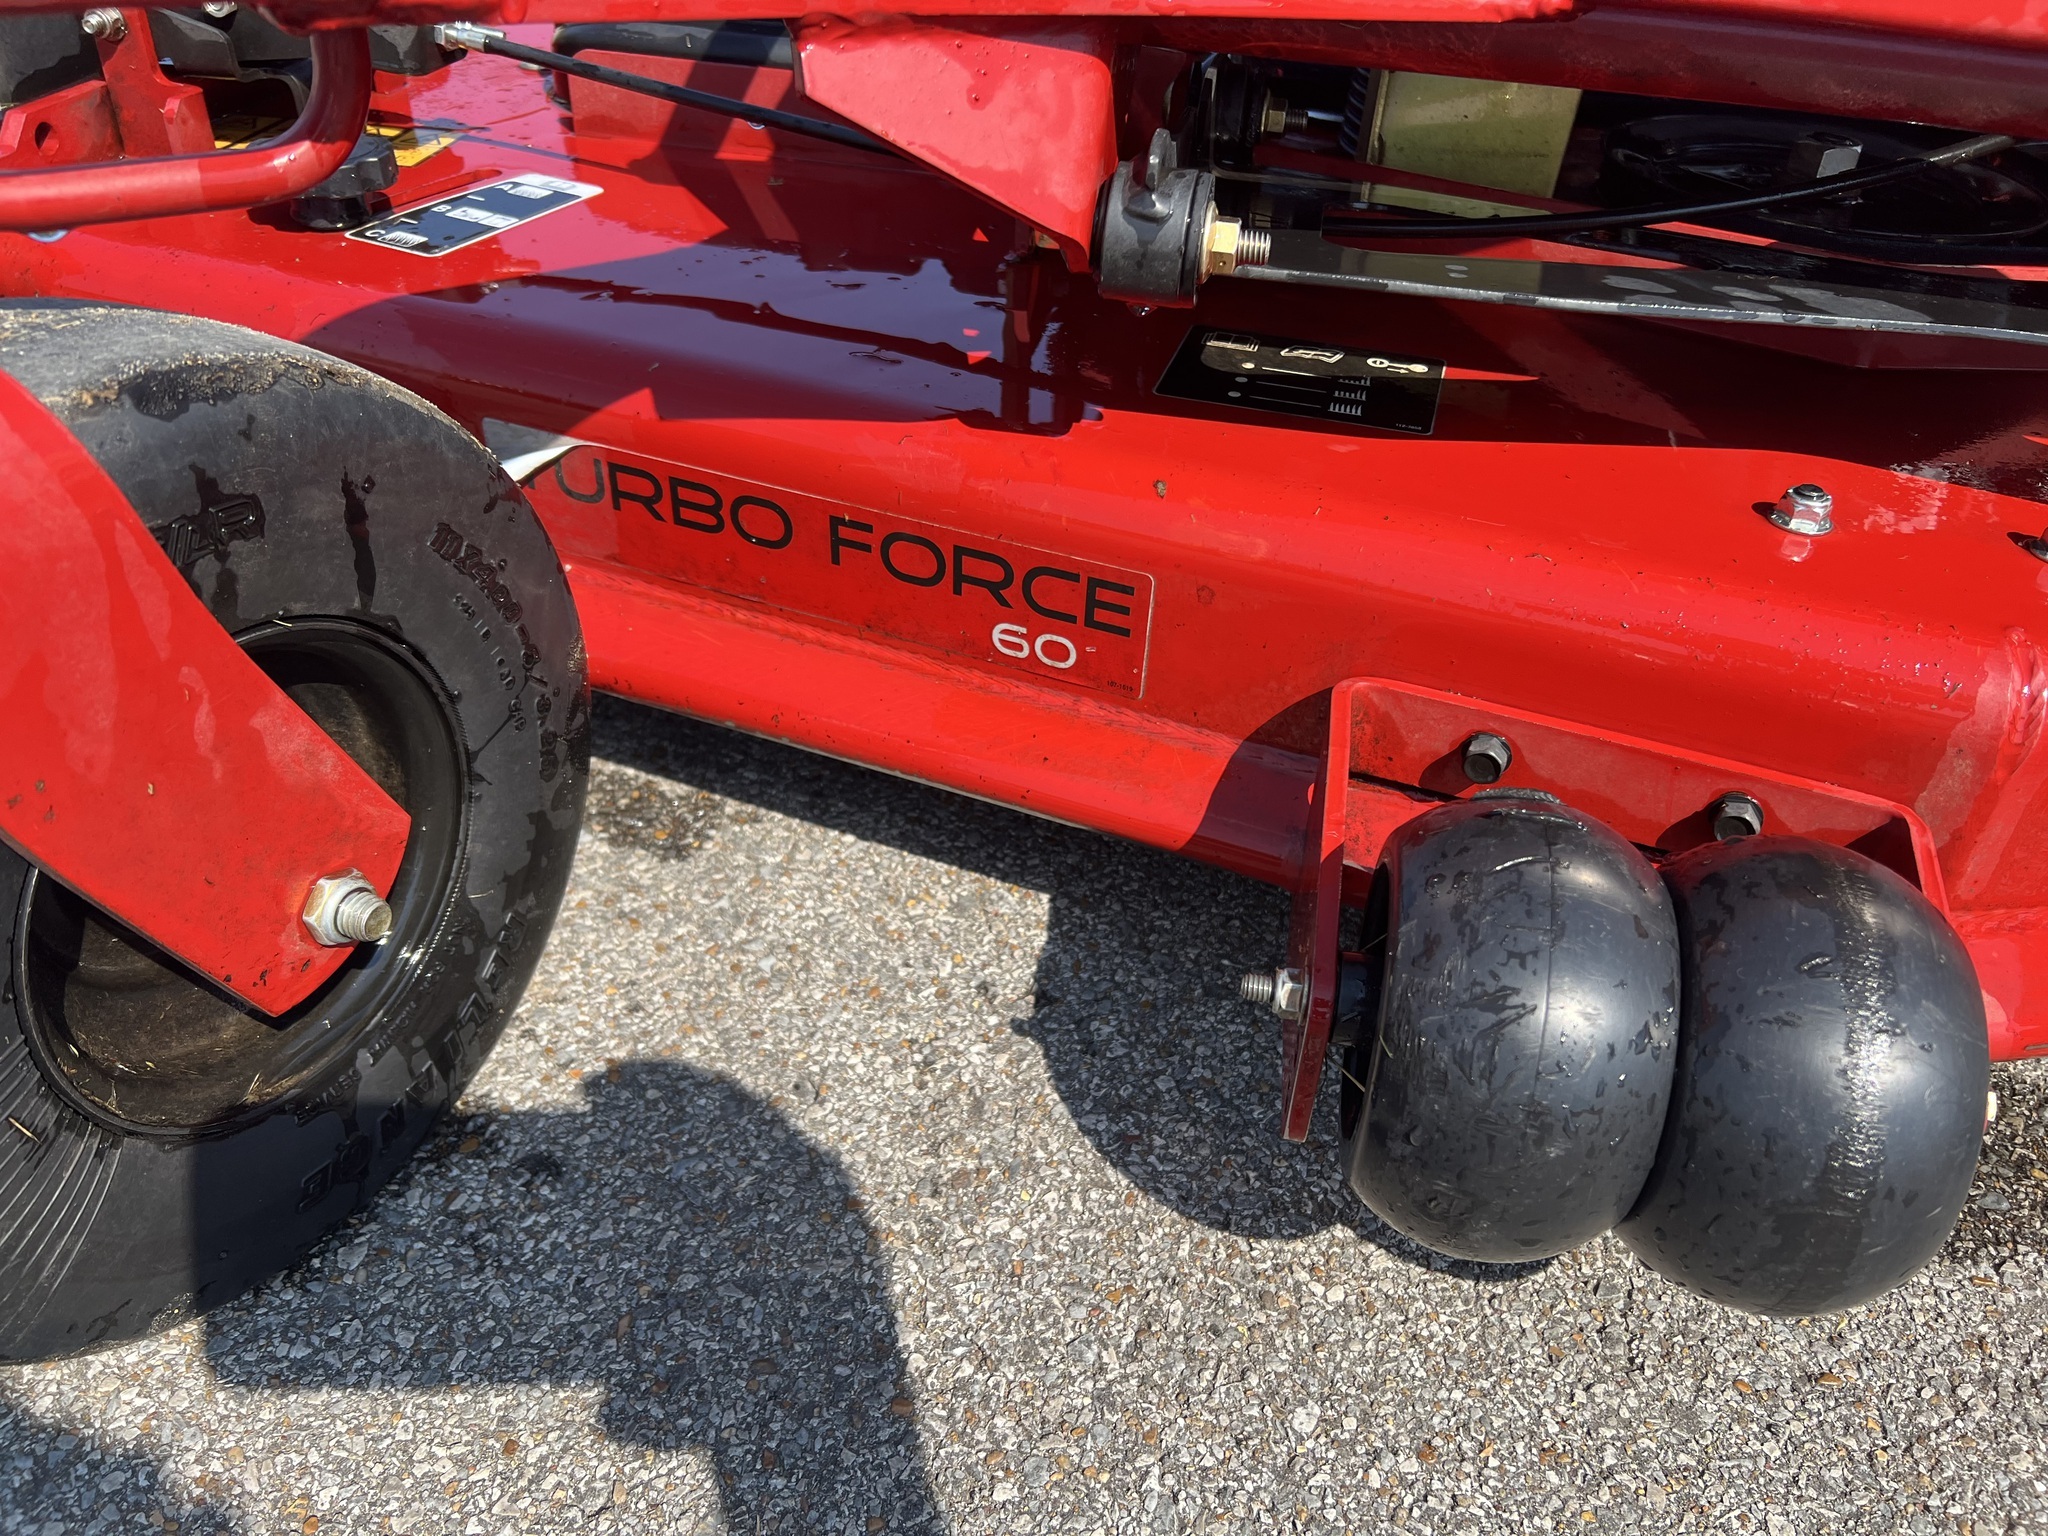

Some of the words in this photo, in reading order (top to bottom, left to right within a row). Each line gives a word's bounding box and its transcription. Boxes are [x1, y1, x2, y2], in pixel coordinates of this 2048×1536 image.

[364, 229, 386, 238] C
[529, 458, 793, 549] URBO
[830, 515, 1136, 638] FORCE
[991, 623, 1077, 669] 60
[298, 911, 527, 1212] RELIANCE
